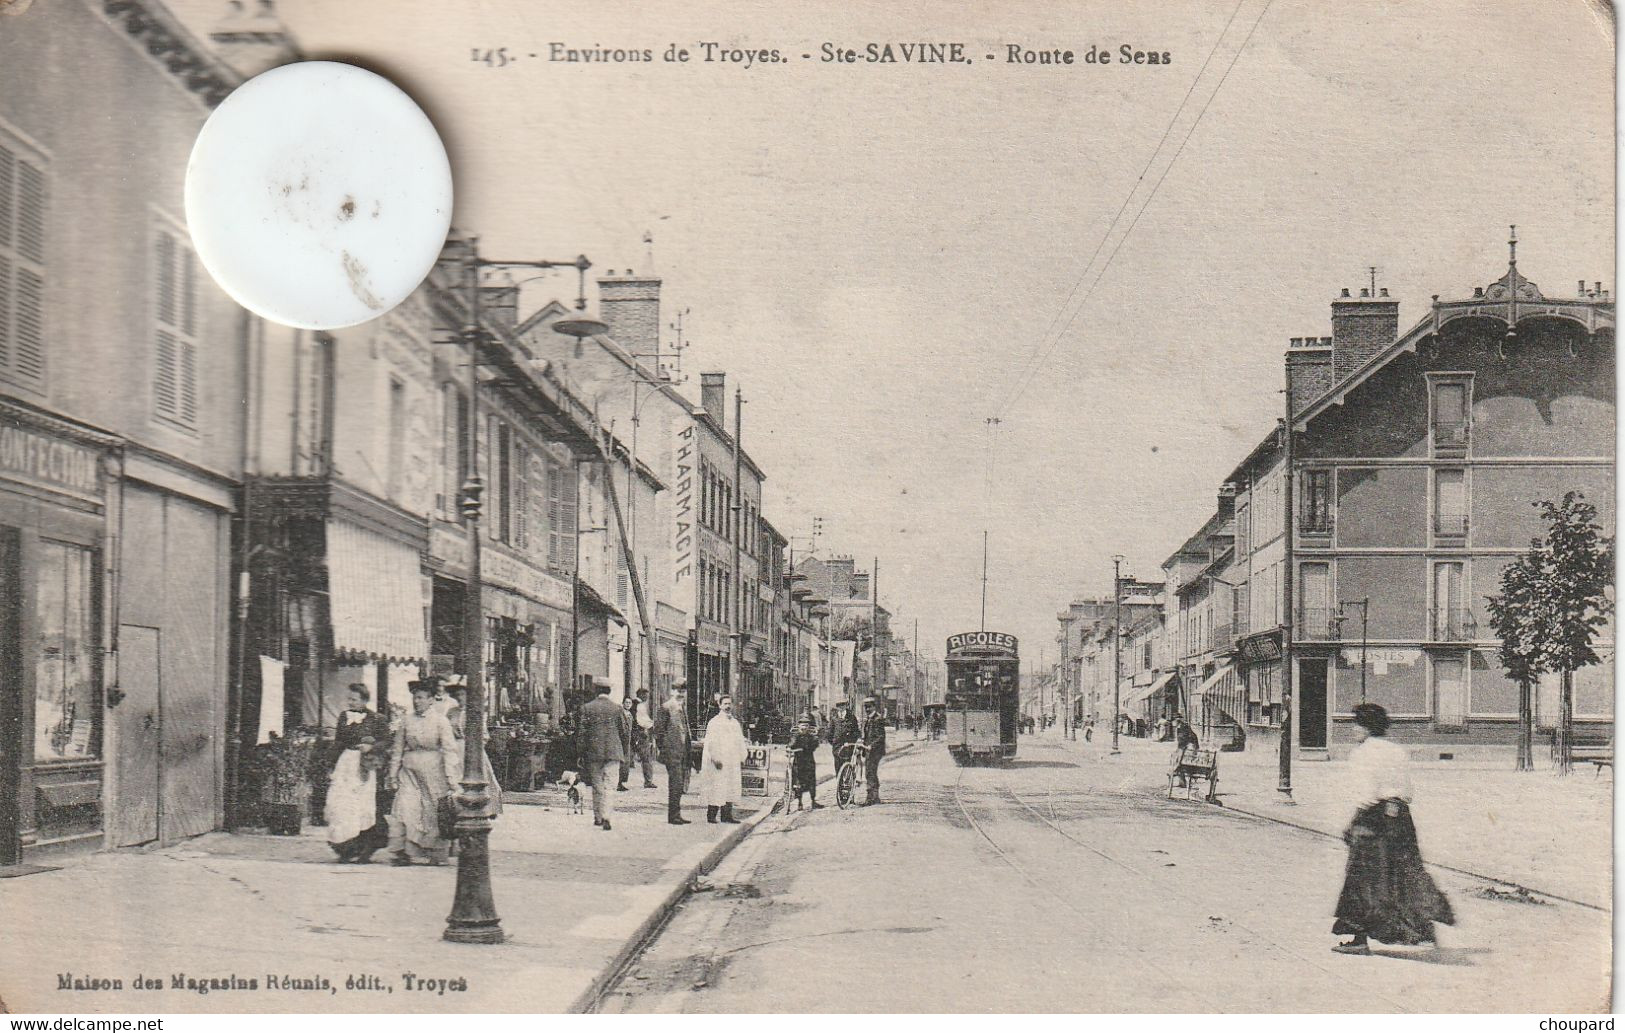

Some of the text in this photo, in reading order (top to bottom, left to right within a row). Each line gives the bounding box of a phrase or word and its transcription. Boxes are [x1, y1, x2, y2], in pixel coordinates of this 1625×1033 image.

[0, 426, 97, 491] ONFECTION
[675, 425, 694, 583] PHARMACIE
[747, 749, 764, 760] TO
